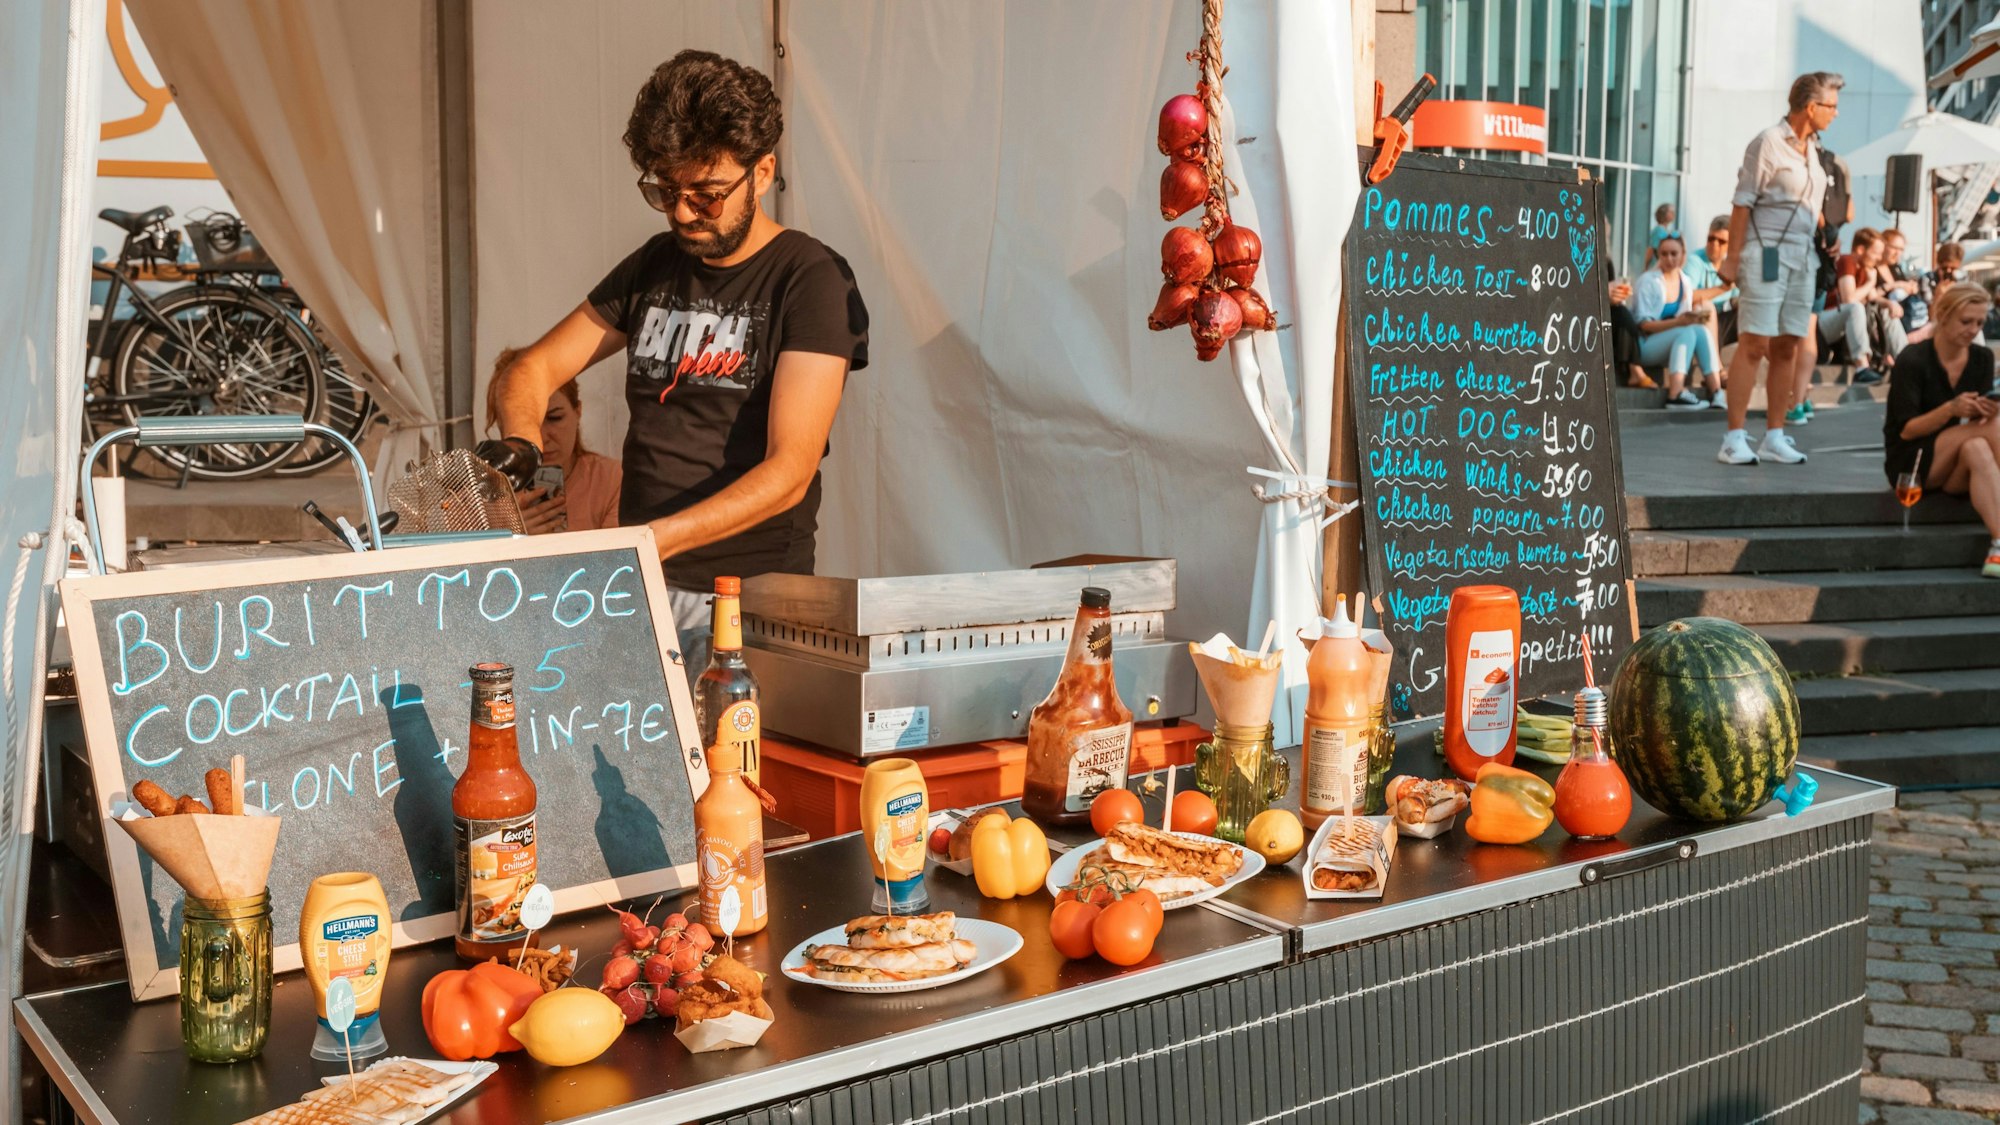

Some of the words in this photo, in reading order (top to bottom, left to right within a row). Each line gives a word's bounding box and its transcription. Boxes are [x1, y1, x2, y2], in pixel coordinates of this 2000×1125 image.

[1364, 188, 1493, 244] Pommes
[1518, 206, 1560, 240] 4.00
[1365, 250, 1465, 289] Chicken
[1530, 264, 1571, 292] 8.00
[1364, 307, 1461, 347] Chicken
[1543, 312, 1600, 355] 6.00
[660, 332, 747, 404] please
[1371, 362, 1444, 394] Fritten
[1523, 360, 1588, 405] 5.50
[1380, 404, 1437, 441] HOT
[1457, 407, 1522, 441] DOG
[1369, 446, 1448, 480] Chicken
[1377, 486, 1453, 522] Chicken
[1472, 507, 1543, 537] popcorn
[1561, 501, 1605, 530] 7.00
[1481, 651, 1512, 659] economy
[326, 917, 376, 935] HELLMANN'S
[337, 941, 367, 956] CHEESE
